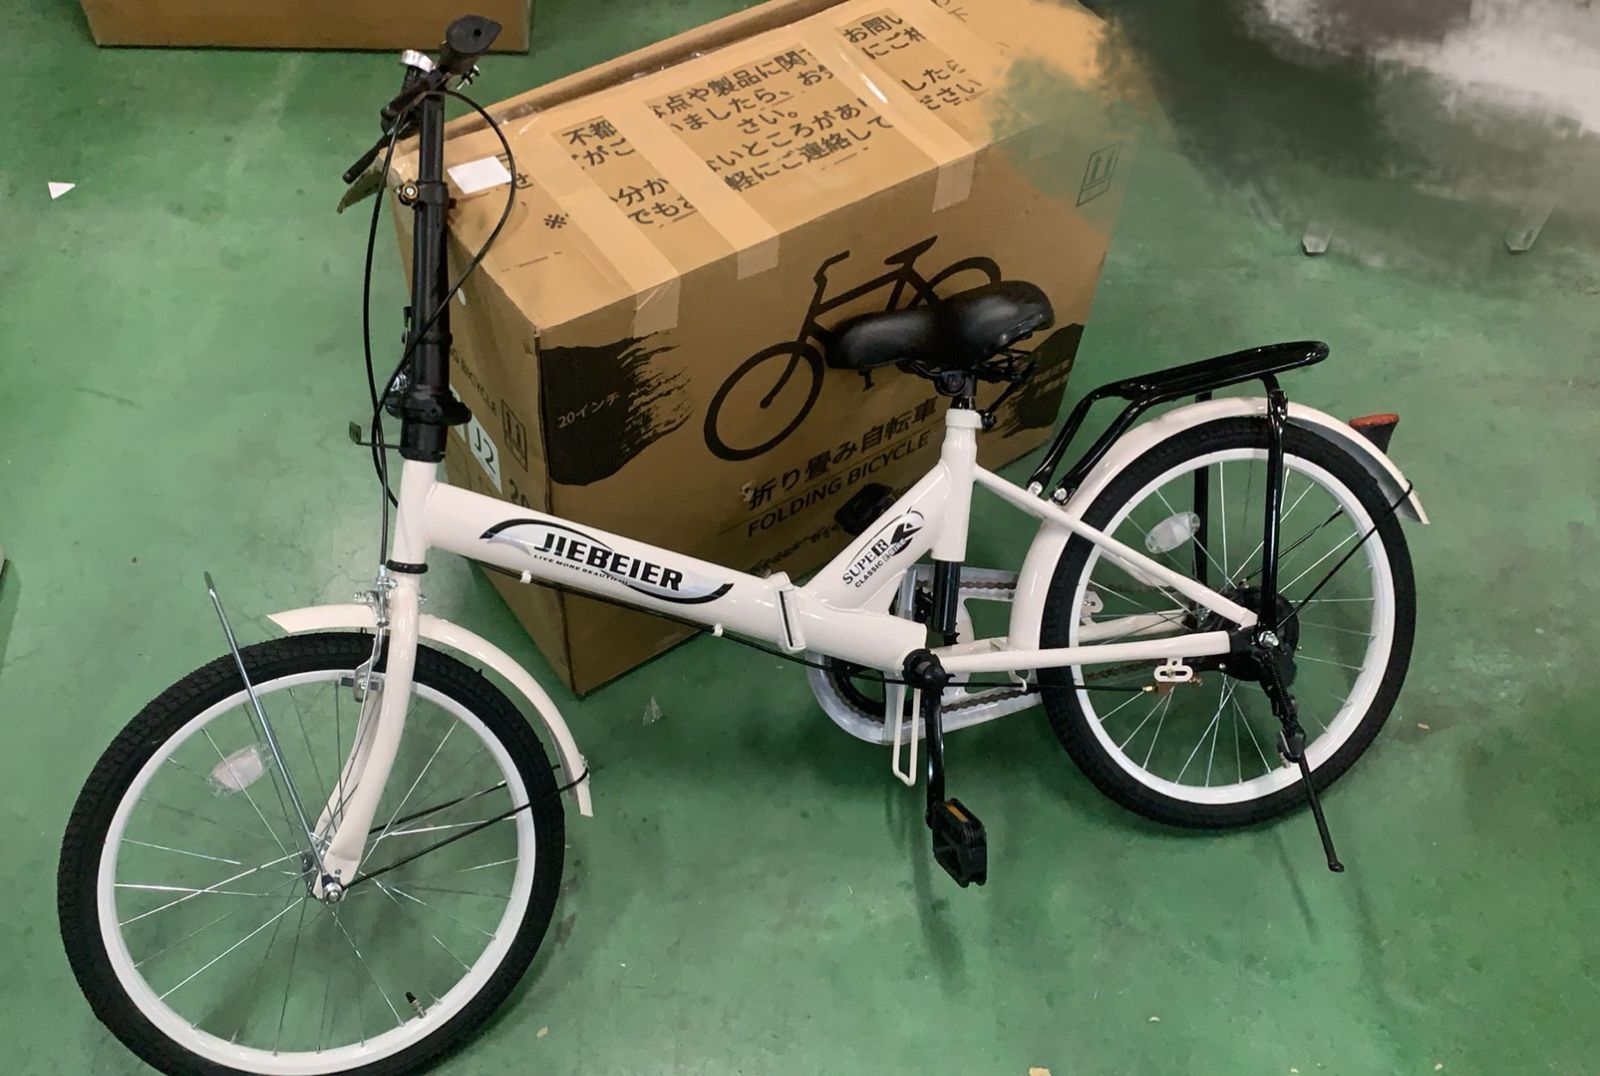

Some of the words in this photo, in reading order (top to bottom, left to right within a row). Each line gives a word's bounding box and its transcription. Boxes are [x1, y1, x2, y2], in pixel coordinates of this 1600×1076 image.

[737, 109, 798, 135] さい。
[609, 178, 669, 206] 分か
[557, 391, 620, 429] 20インチ
[749, 396, 938, 511] 折り畳み自転車
[747, 476, 842, 538] FOLDING
[847, 429, 930, 486] BICYCLE
[533, 554, 554, 563] LIVE
[555, 560, 580, 571] MORE
[534, 532, 683, 592] JIEBEIER
[842, 538, 890, 585] SUPER
[854, 560, 884, 588] CLASSIC
